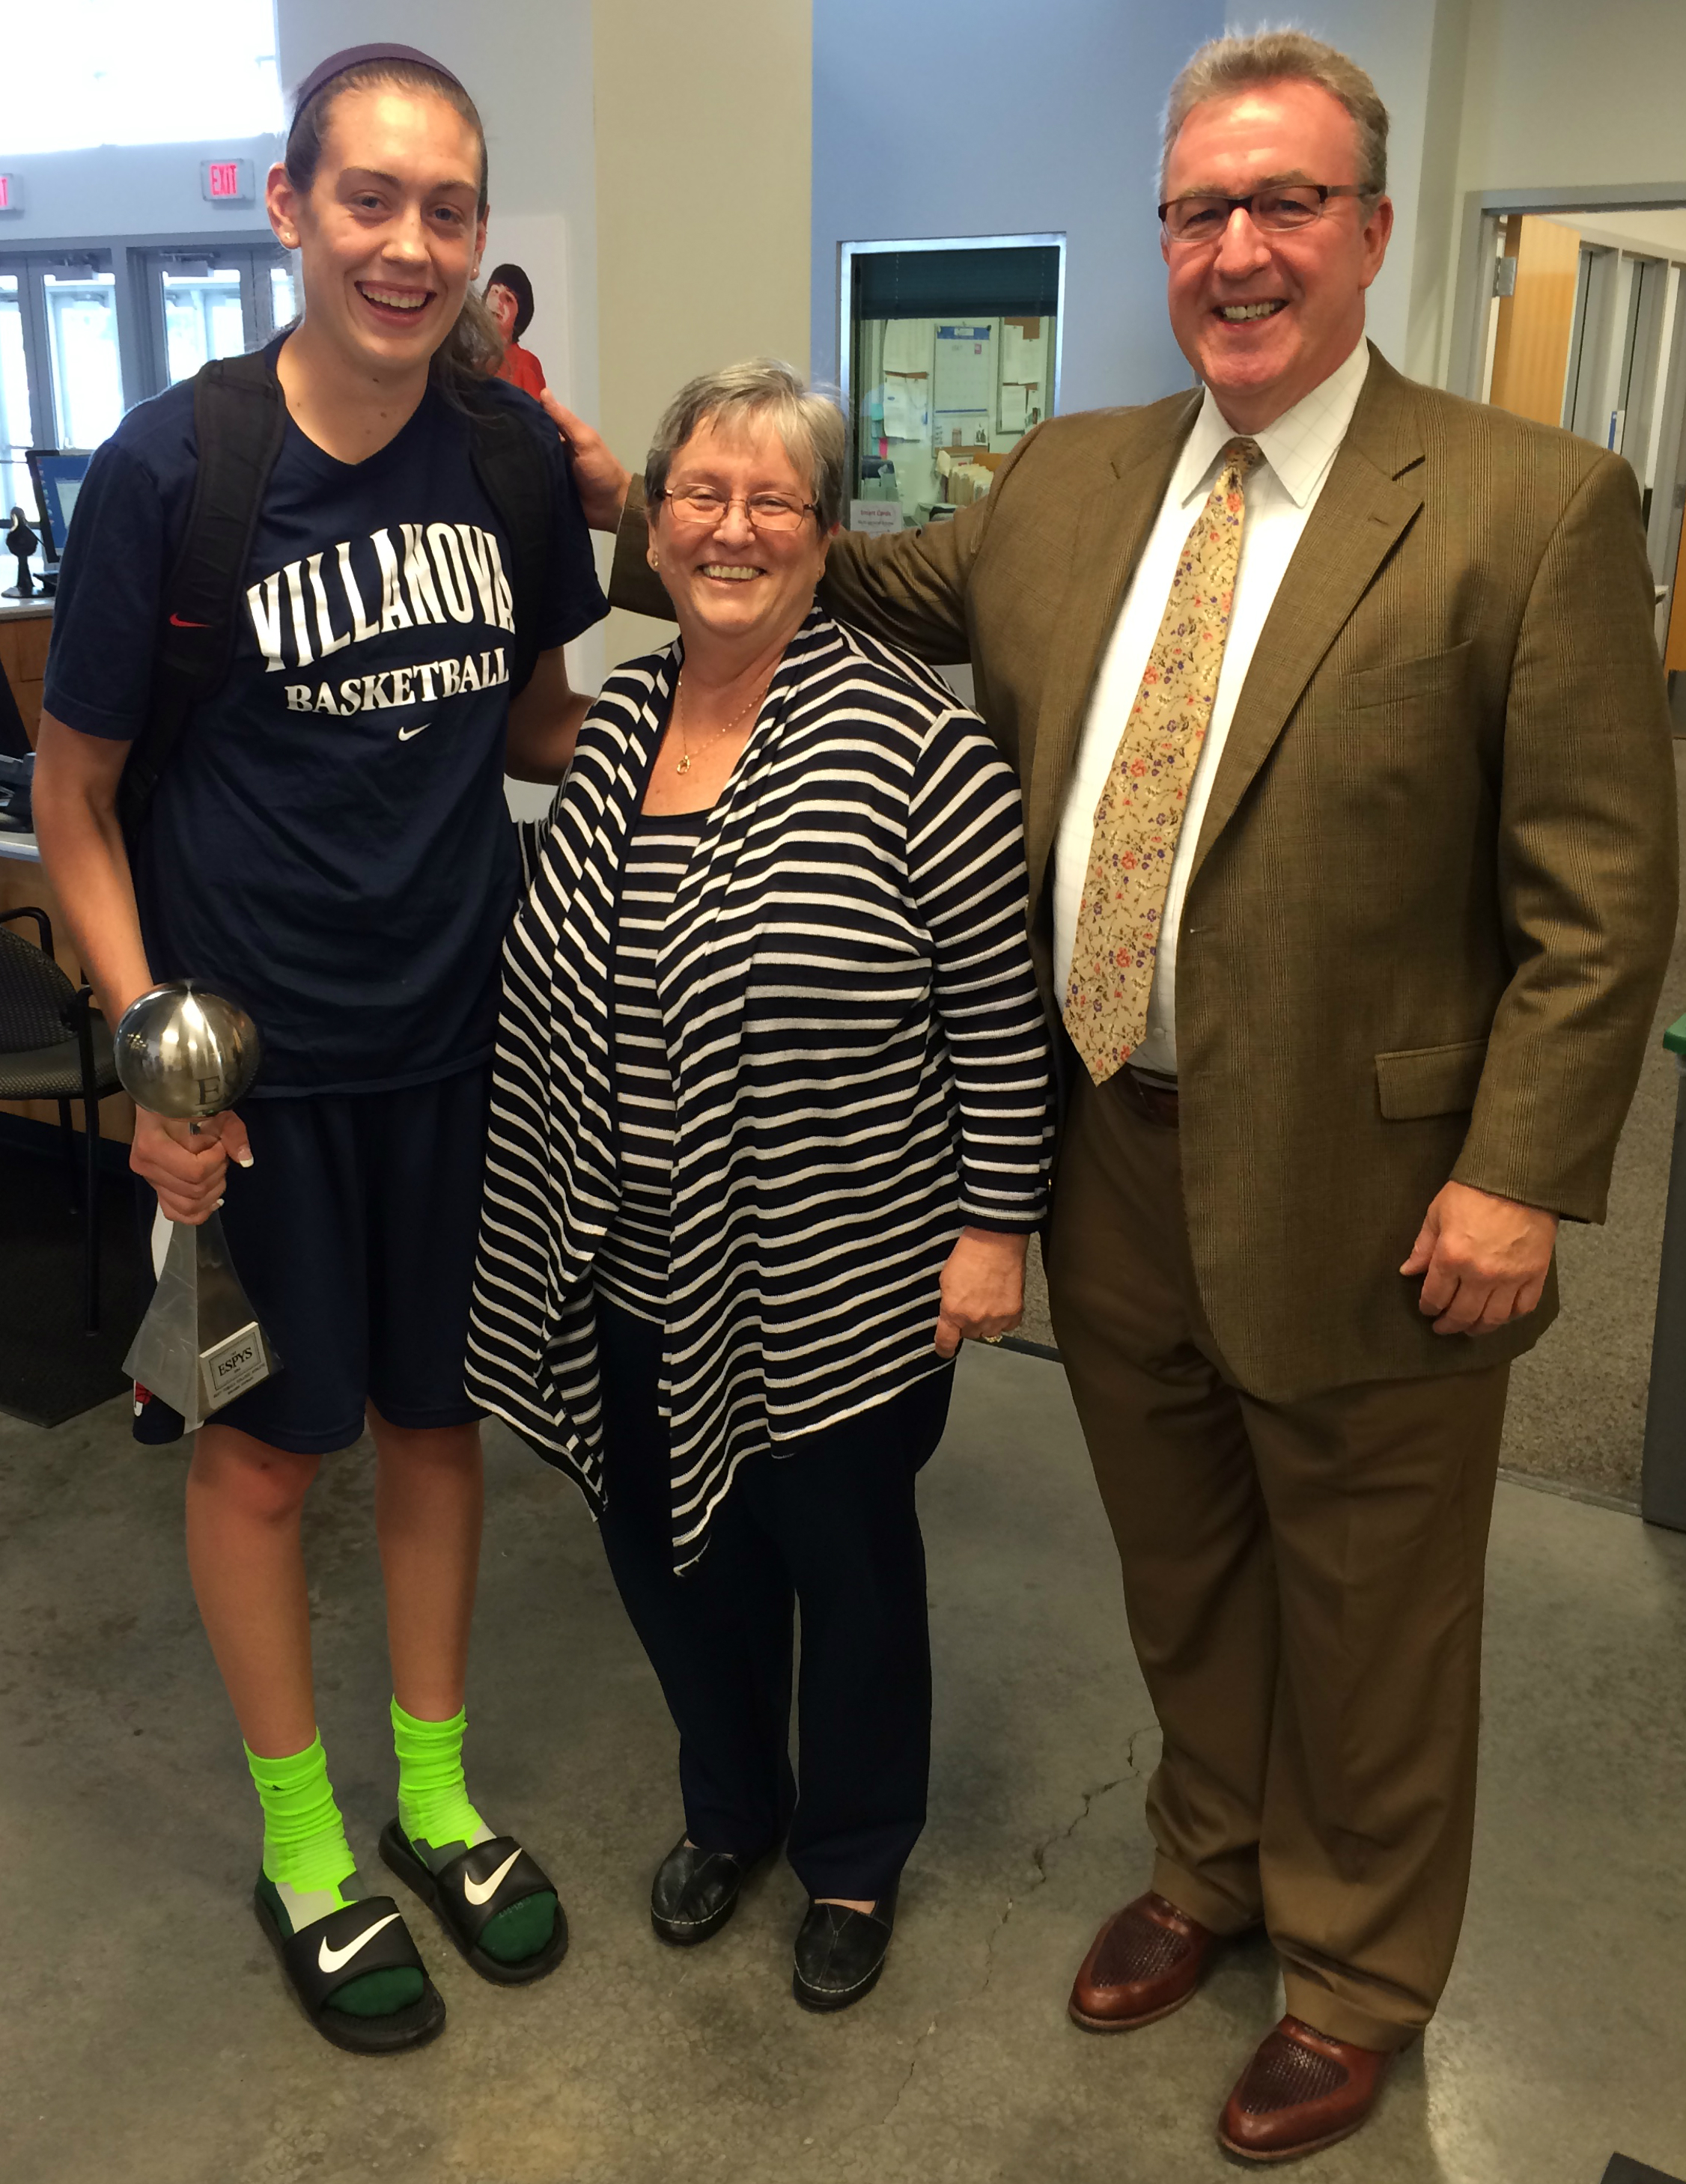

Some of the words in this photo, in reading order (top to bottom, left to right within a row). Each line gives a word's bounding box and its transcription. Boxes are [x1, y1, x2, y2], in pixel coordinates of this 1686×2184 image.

[211, 165, 237, 195] EXIT
[246, 522, 516, 672] VILLANOVA
[284, 647, 510, 716] BASKETBALL
[218, 1347, 253, 1376] ESPYS
